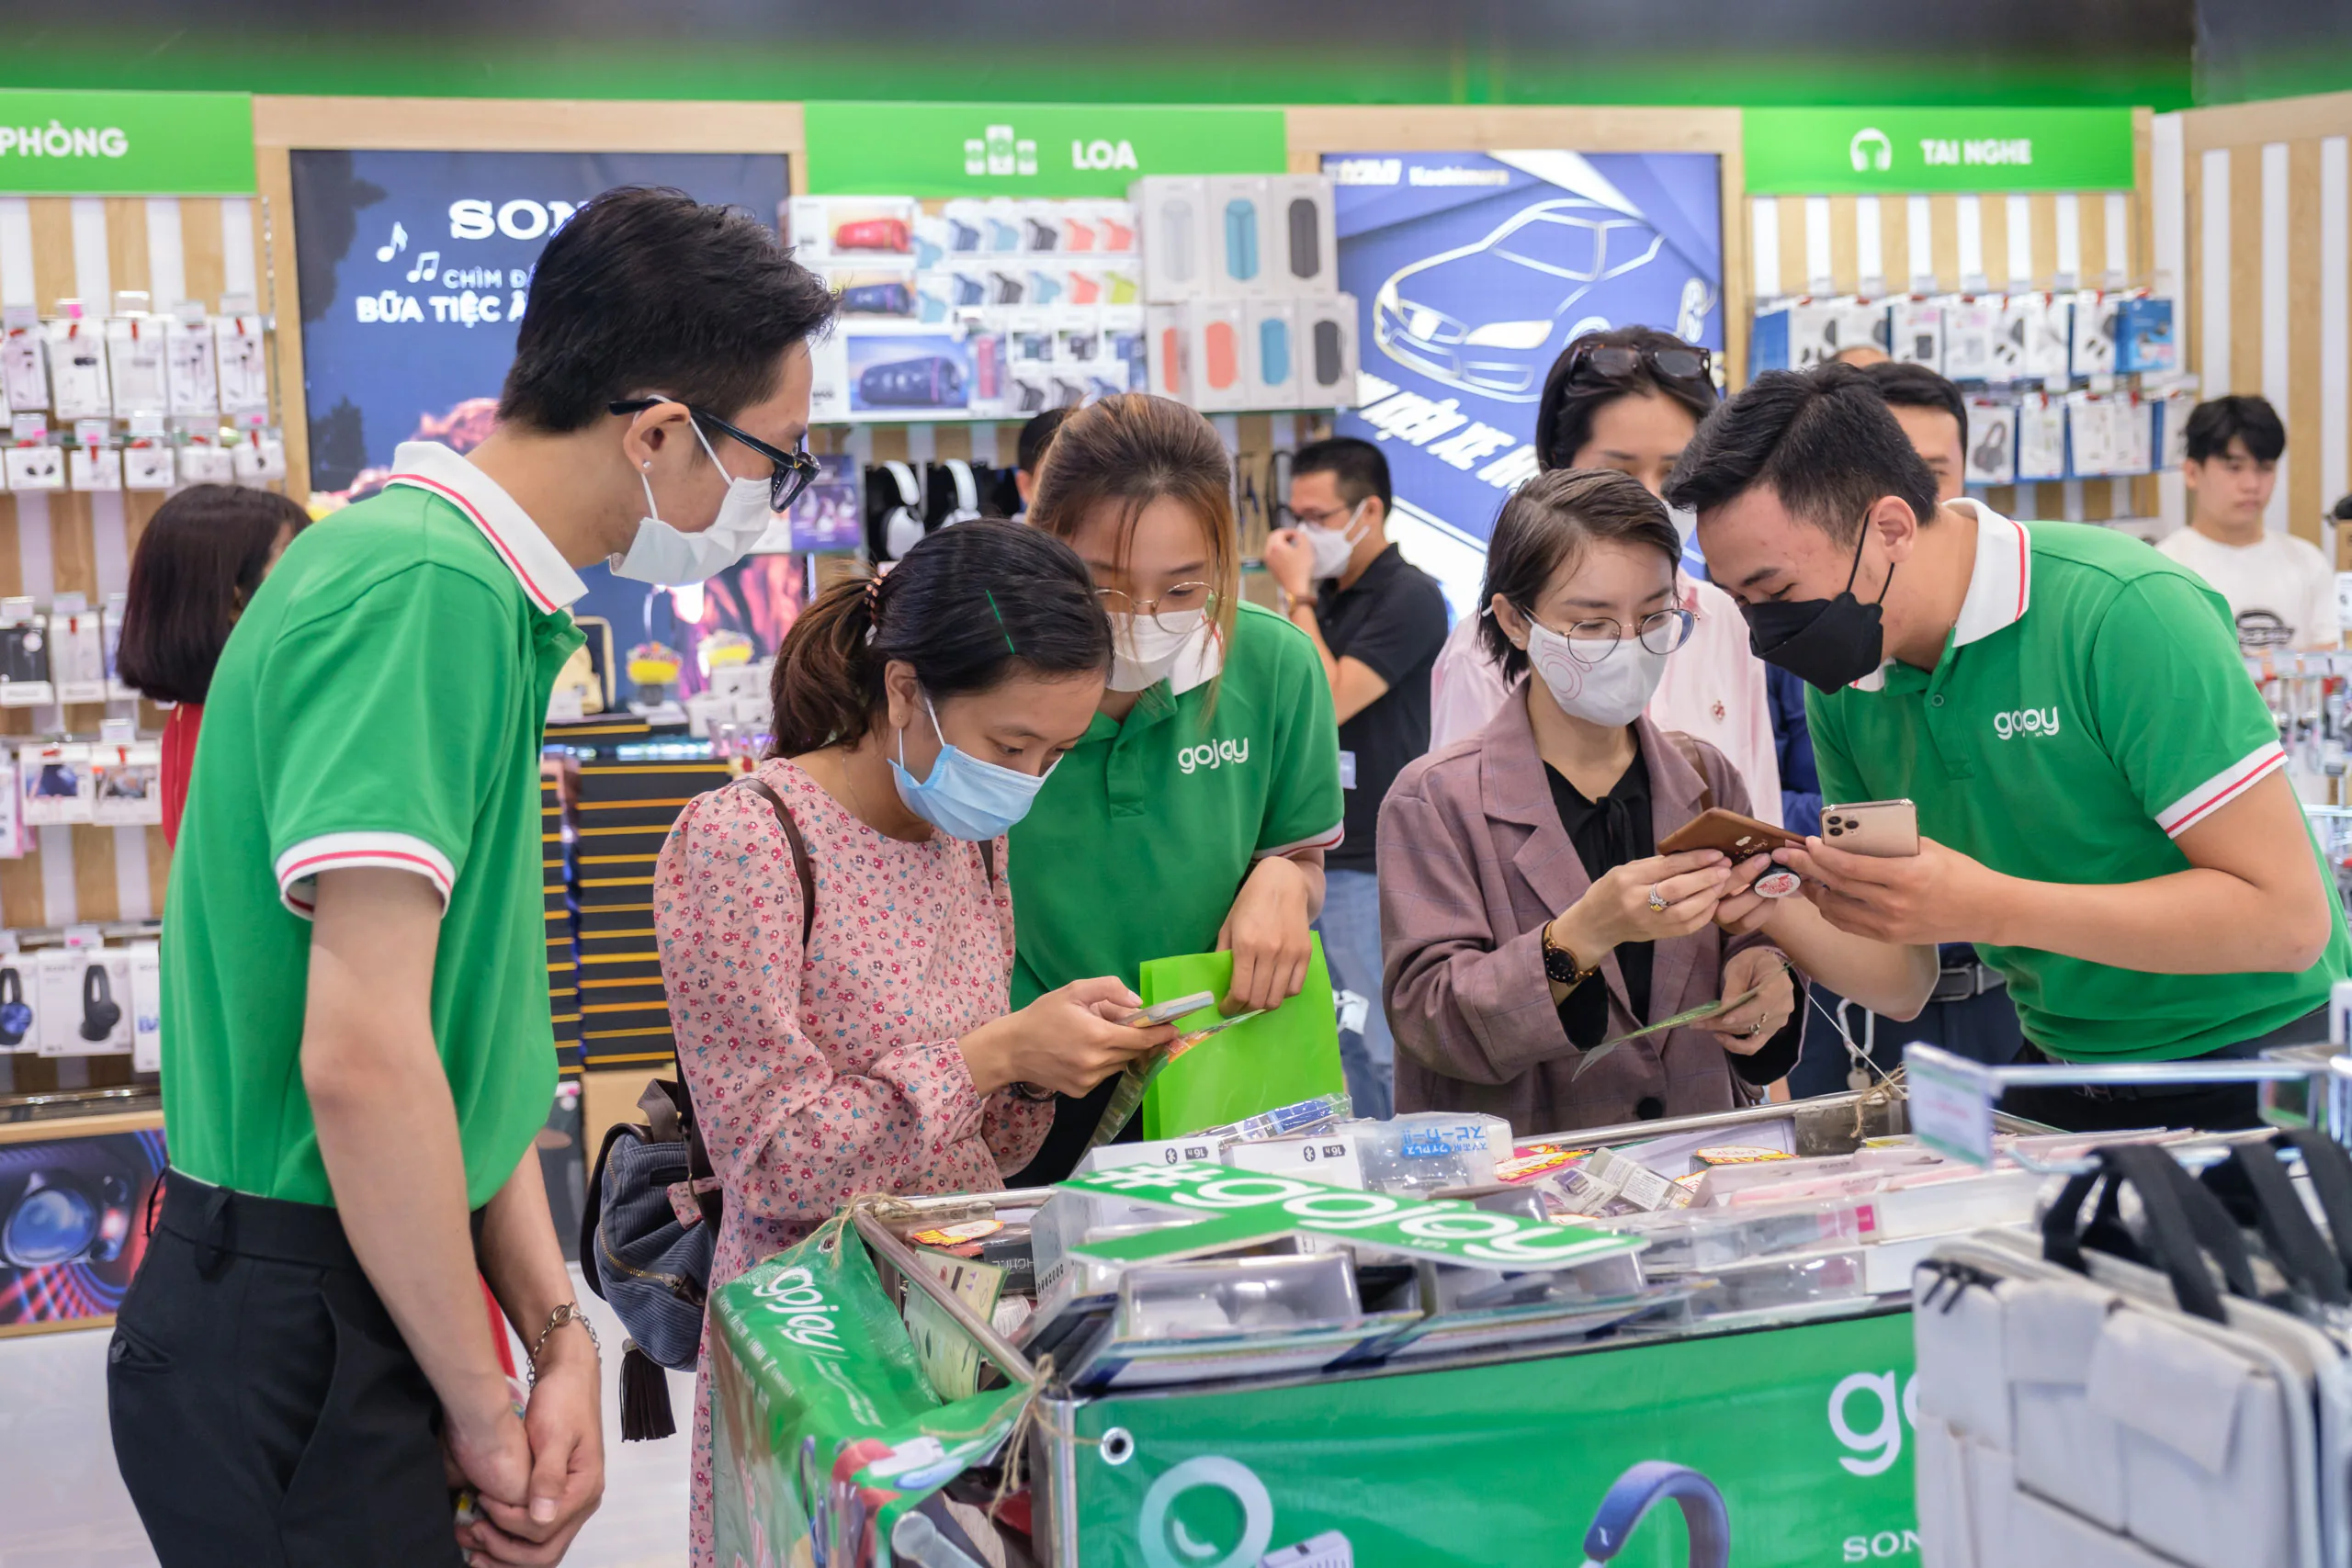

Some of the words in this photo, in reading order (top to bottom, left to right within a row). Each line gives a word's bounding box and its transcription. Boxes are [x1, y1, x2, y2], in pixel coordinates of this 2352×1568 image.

[0, 118, 129, 157] PHÒNG
[1071, 139, 1139, 171] LOA
[1919, 138, 1959, 165] TAI
[1963, 138, 2032, 165] NGHE
[443, 265, 503, 288] CHÌM
[356, 289, 425, 322] BỮA
[428, 289, 502, 329] TIỆC
[1178, 737, 1249, 774] gojoy
[752, 1267, 846, 1352] gojoy
